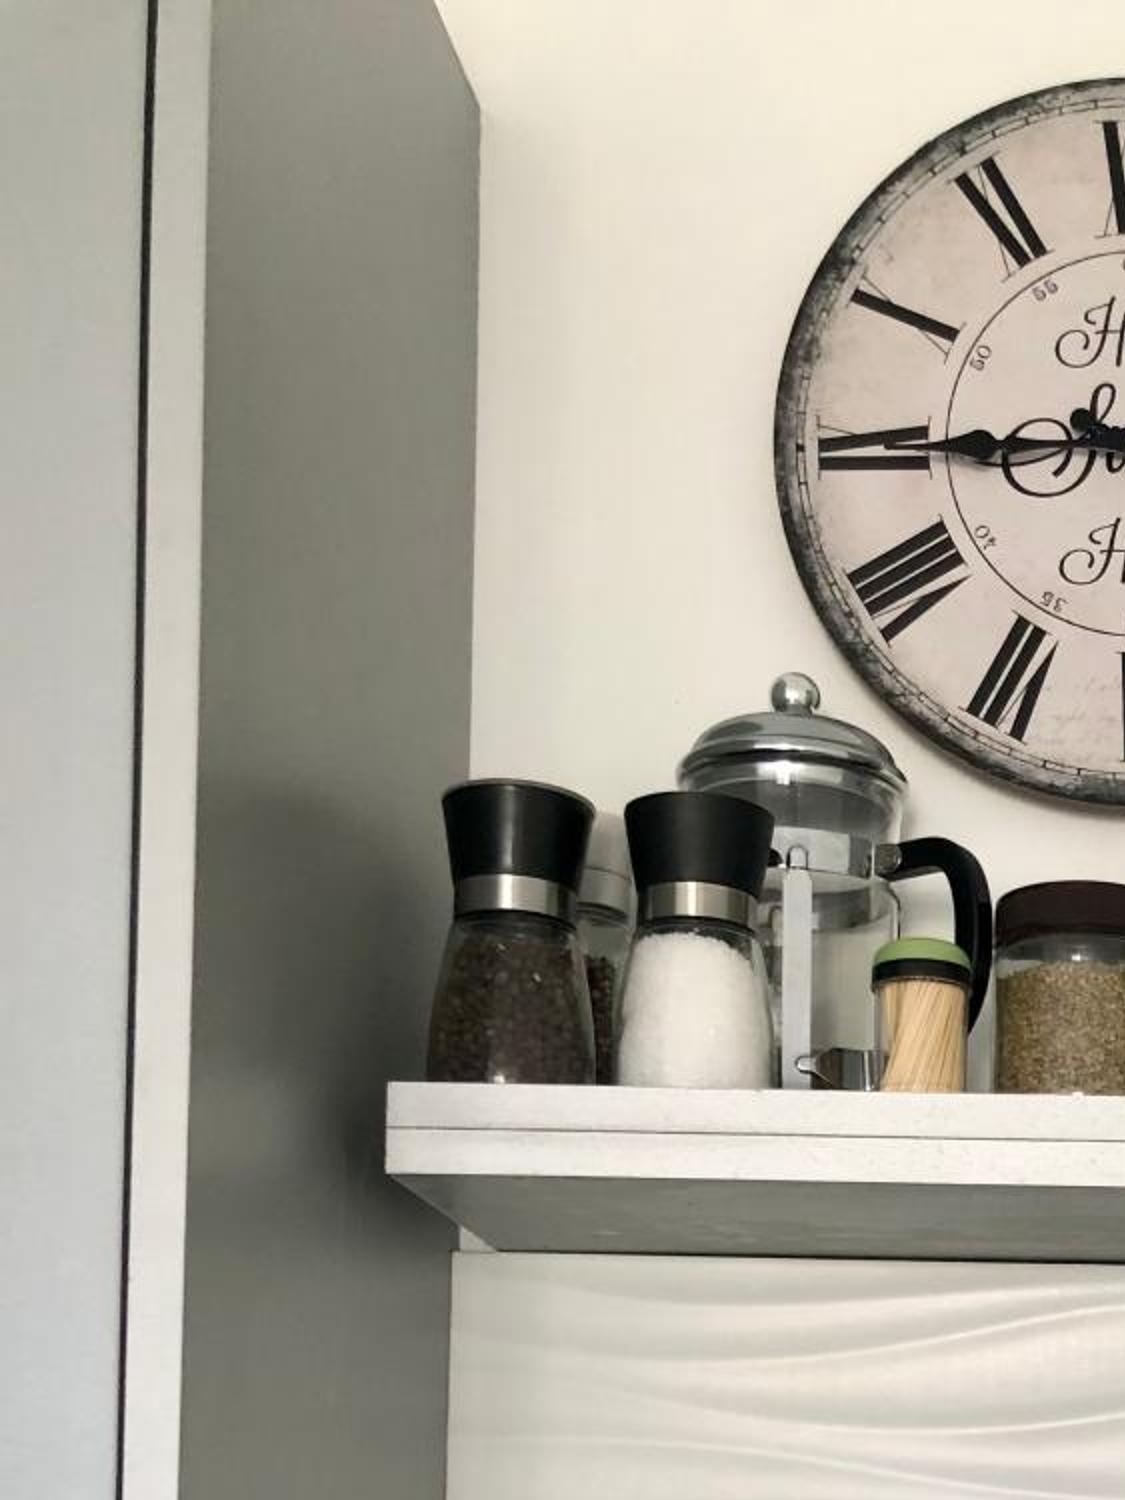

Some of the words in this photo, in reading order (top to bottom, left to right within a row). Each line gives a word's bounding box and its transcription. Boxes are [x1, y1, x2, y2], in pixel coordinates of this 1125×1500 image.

[947, 151, 1055, 284] XI
[847, 272, 967, 365] X
[1031, 281, 1060, 302] 55
[968, 344, 992, 372] 50
[972, 524, 997, 551] 40
[841, 514, 973, 649] VIII
[1041, 590, 1069, 613] 35
[957, 609, 1061, 746] VII
